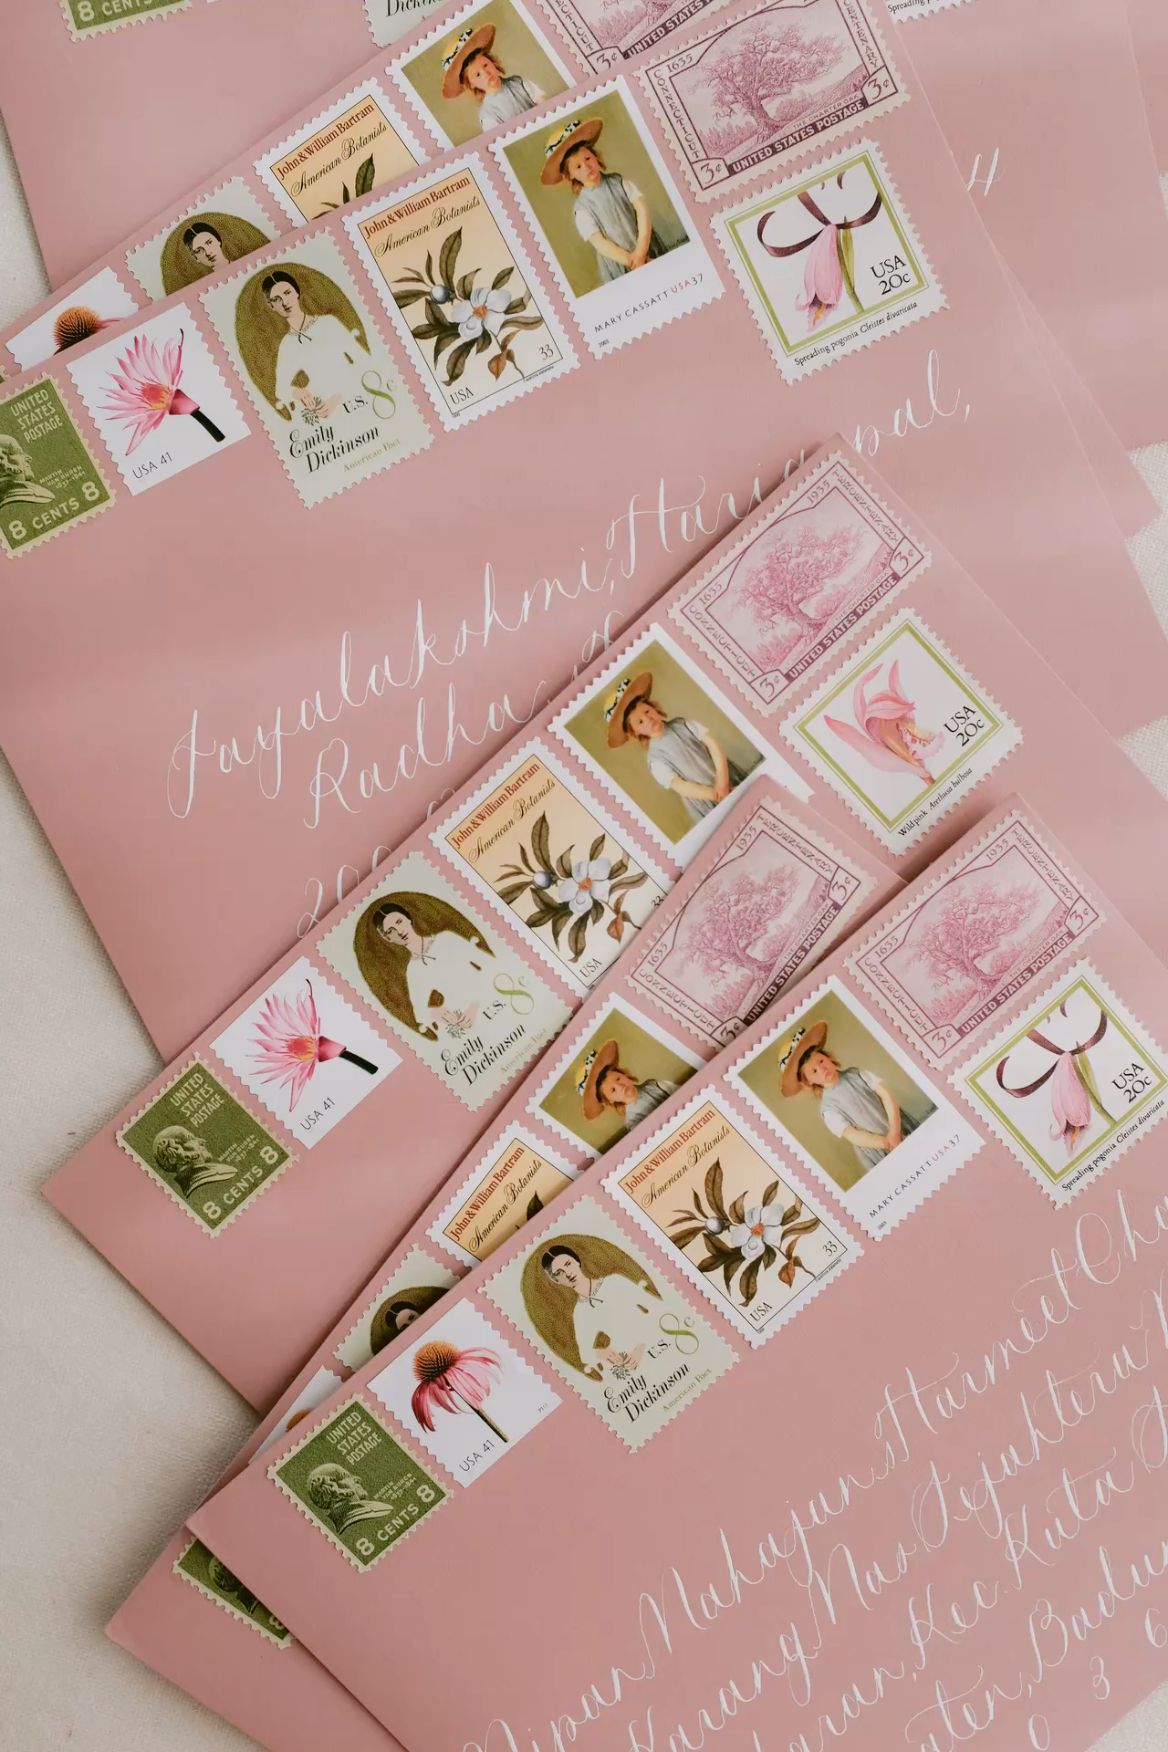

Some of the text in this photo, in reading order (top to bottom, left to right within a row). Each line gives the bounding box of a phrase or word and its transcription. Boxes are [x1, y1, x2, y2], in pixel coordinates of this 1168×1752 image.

[77, 0, 95, 22] 8
[628, 0, 704, 58] UNITED STATES
[667, 54, 693, 74] 1635
[336, 104, 375, 135] Bartram
[733, 102, 864, 173] UNITED STATES POSTAGE
[291, 121, 387, 197] American Botanists
[430, 176, 470, 202] Bartram
[374, 196, 480, 258] American Botanists
[870, 255, 906, 279] USA
[878, 273, 911, 295] 20c
[594, 313, 622, 333] MARY
[624, 290, 668, 317] CASSATT
[794, 301, 918, 366] Spreading pogonia Cleistes divaricata
[538, 344, 554, 361] 33
[10, 388, 49, 417] UNITED
[342, 395, 368, 414] U.S.
[450, 386, 474, 406] USA
[17, 400, 56, 431] STATES
[24, 415, 63, 443] POSTAGE
[289, 425, 334, 458] Emily
[306, 426, 380, 473] Dickinson
[132, 451, 173, 480] USA 41
[343, 449, 382, 472] American
[82, 481, 100, 501] 8
[805, 480, 830, 504] 1935
[8, 497, 80, 540] 8 CENTS
[698, 581, 723, 606] 1635
[788, 574, 897, 678] UNITED STATES POSTAGE
[944, 705, 977, 734] USA
[955, 718, 985, 747] 20c
[504, 762, 541, 798] Bartram
[898, 767, 973, 837] Wild pink Arethusa bulbosa
[469, 778, 556, 863] American Botanists
[735, 825, 757, 851] 1935
[985, 838, 1009, 861] 1935
[647, 942, 668, 968] 1635
[874, 935, 899, 959] 1635
[579, 957, 603, 979] USA
[747, 984, 778, 1023] UNITED
[775, 948, 804, 987] STATES
[803, 906, 838, 949] POSTAGE
[961, 933, 1073, 1033] UNITED STATES POSTAGE
[482, 999, 507, 1021] U.S.
[440, 1035, 484, 1076] Emily
[461, 1023, 526, 1087] Dickinson
[170, 1073, 204, 1107] UNITED
[1111, 1062, 1145, 1091] USA
[1123, 1077, 1153, 1104] 20c
[181, 1083, 214, 1118] STATES
[190, 1093, 225, 1128] POSTAGE
[300, 1096, 336, 1131] USA 41
[678, 1109, 716, 1144] Bartram
[260, 1145, 279, 1165] 8
[1061, 1099, 1165, 1192] Spreading pogonia Cleistes divaricata
[493, 1146, 525, 1186] Bartram
[641, 1126, 730, 1208] American Botanists
[202, 1165, 264, 1220] 8 CENTS
[468, 1159, 542, 1252] American Botanists
[869, 1195, 894, 1218] MARY
[894, 1160, 932, 1196] CASSATT
[822, 1240, 838, 1257] 33
[750, 1302, 773, 1323] USA
[647, 1339, 672, 1359] U.S.
[603, 1375, 648, 1414] Emily
[624, 1363, 690, 1423] Dickinson
[662, 1368, 712, 1412] American Poet
[326, 1411, 362, 1445] UNITED
[337, 1422, 372, 1456] STATES
[345, 1431, 383, 1466] POSTAGE
[459, 1439, 496, 1472] USA 41
[416, 1484, 436, 1504] 8
[355, 1503, 419, 1556] 8 CENTS
